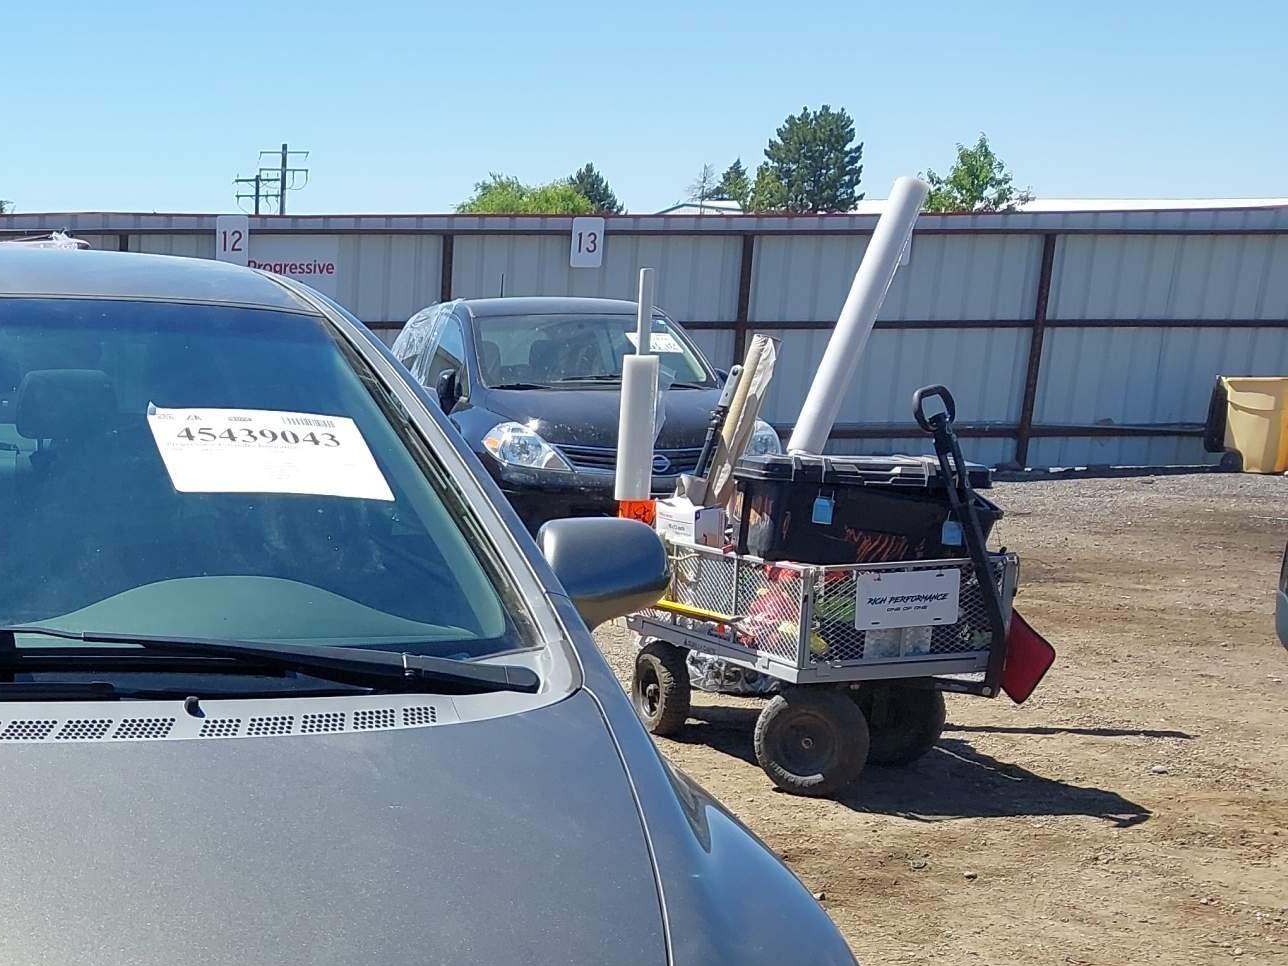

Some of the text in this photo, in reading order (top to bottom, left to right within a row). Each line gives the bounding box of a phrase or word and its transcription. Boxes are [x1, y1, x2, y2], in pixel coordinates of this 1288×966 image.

[223, 230, 243, 252] 12
[577, 231, 598, 253] 13
[176, 426, 342, 448] 45439043
[867, 592, 950, 606] RICH PERFORMANCE
